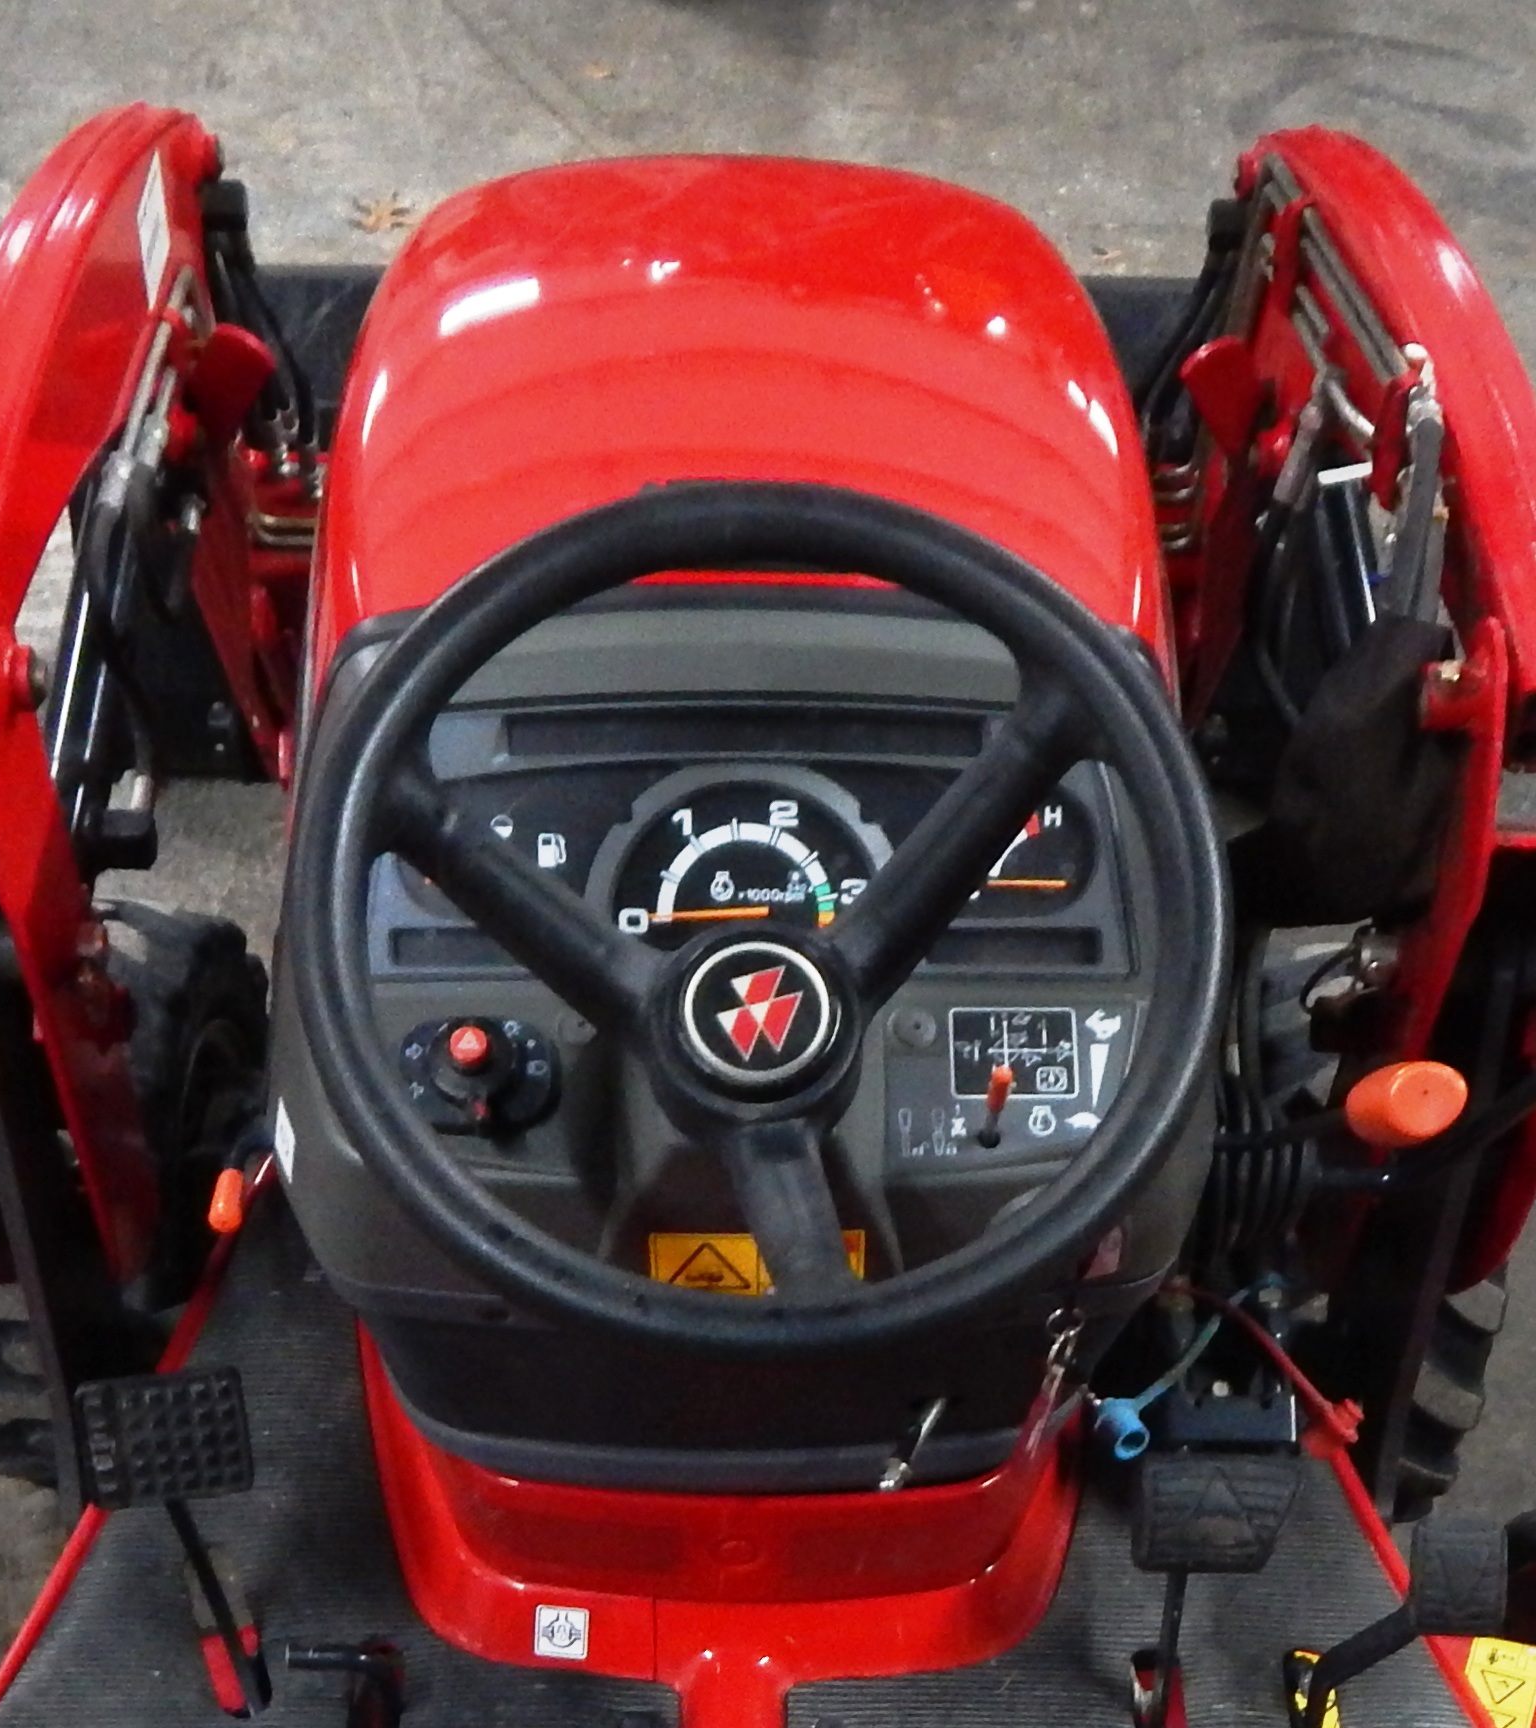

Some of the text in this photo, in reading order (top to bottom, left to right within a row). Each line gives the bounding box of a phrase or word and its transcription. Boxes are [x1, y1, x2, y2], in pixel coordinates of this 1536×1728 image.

[671, 808, 694, 836] 1
[769, 800, 799, 828] 2
[1044, 805, 1063, 828] H
[618, 907, 650, 934] 0
